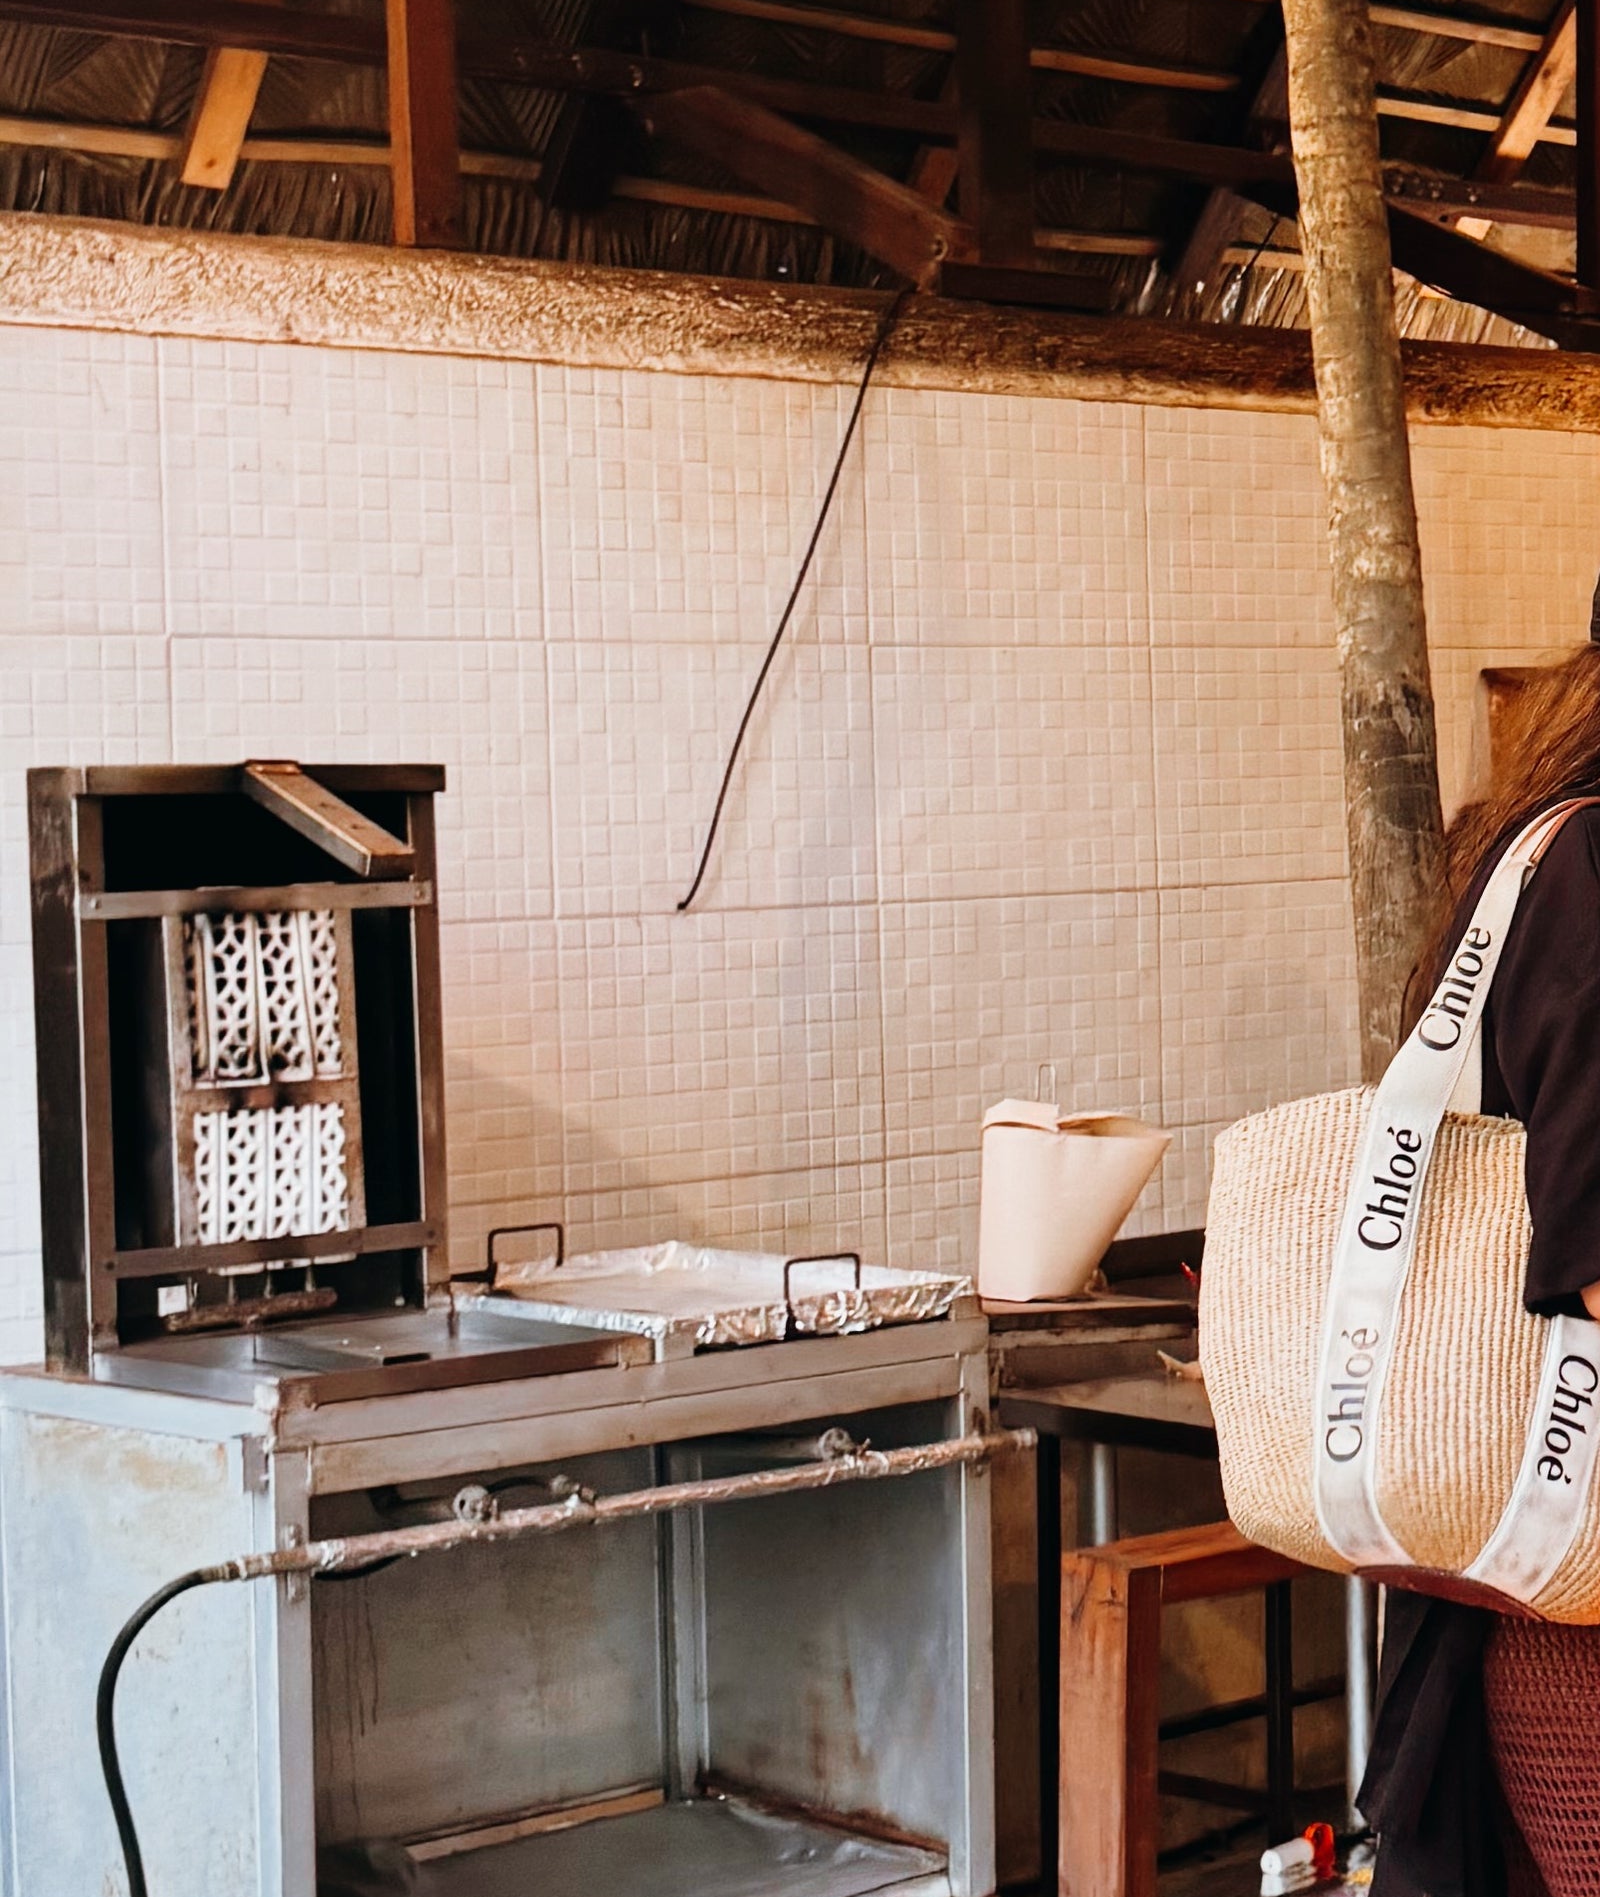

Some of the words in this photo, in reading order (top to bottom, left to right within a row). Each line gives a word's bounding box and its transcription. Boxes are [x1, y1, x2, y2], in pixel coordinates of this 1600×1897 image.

[1357, 1125, 1423, 1252] Chloé
[1325, 1327, 1380, 1463] Chloé
[1536, 1354, 1599, 1485] Chloé
